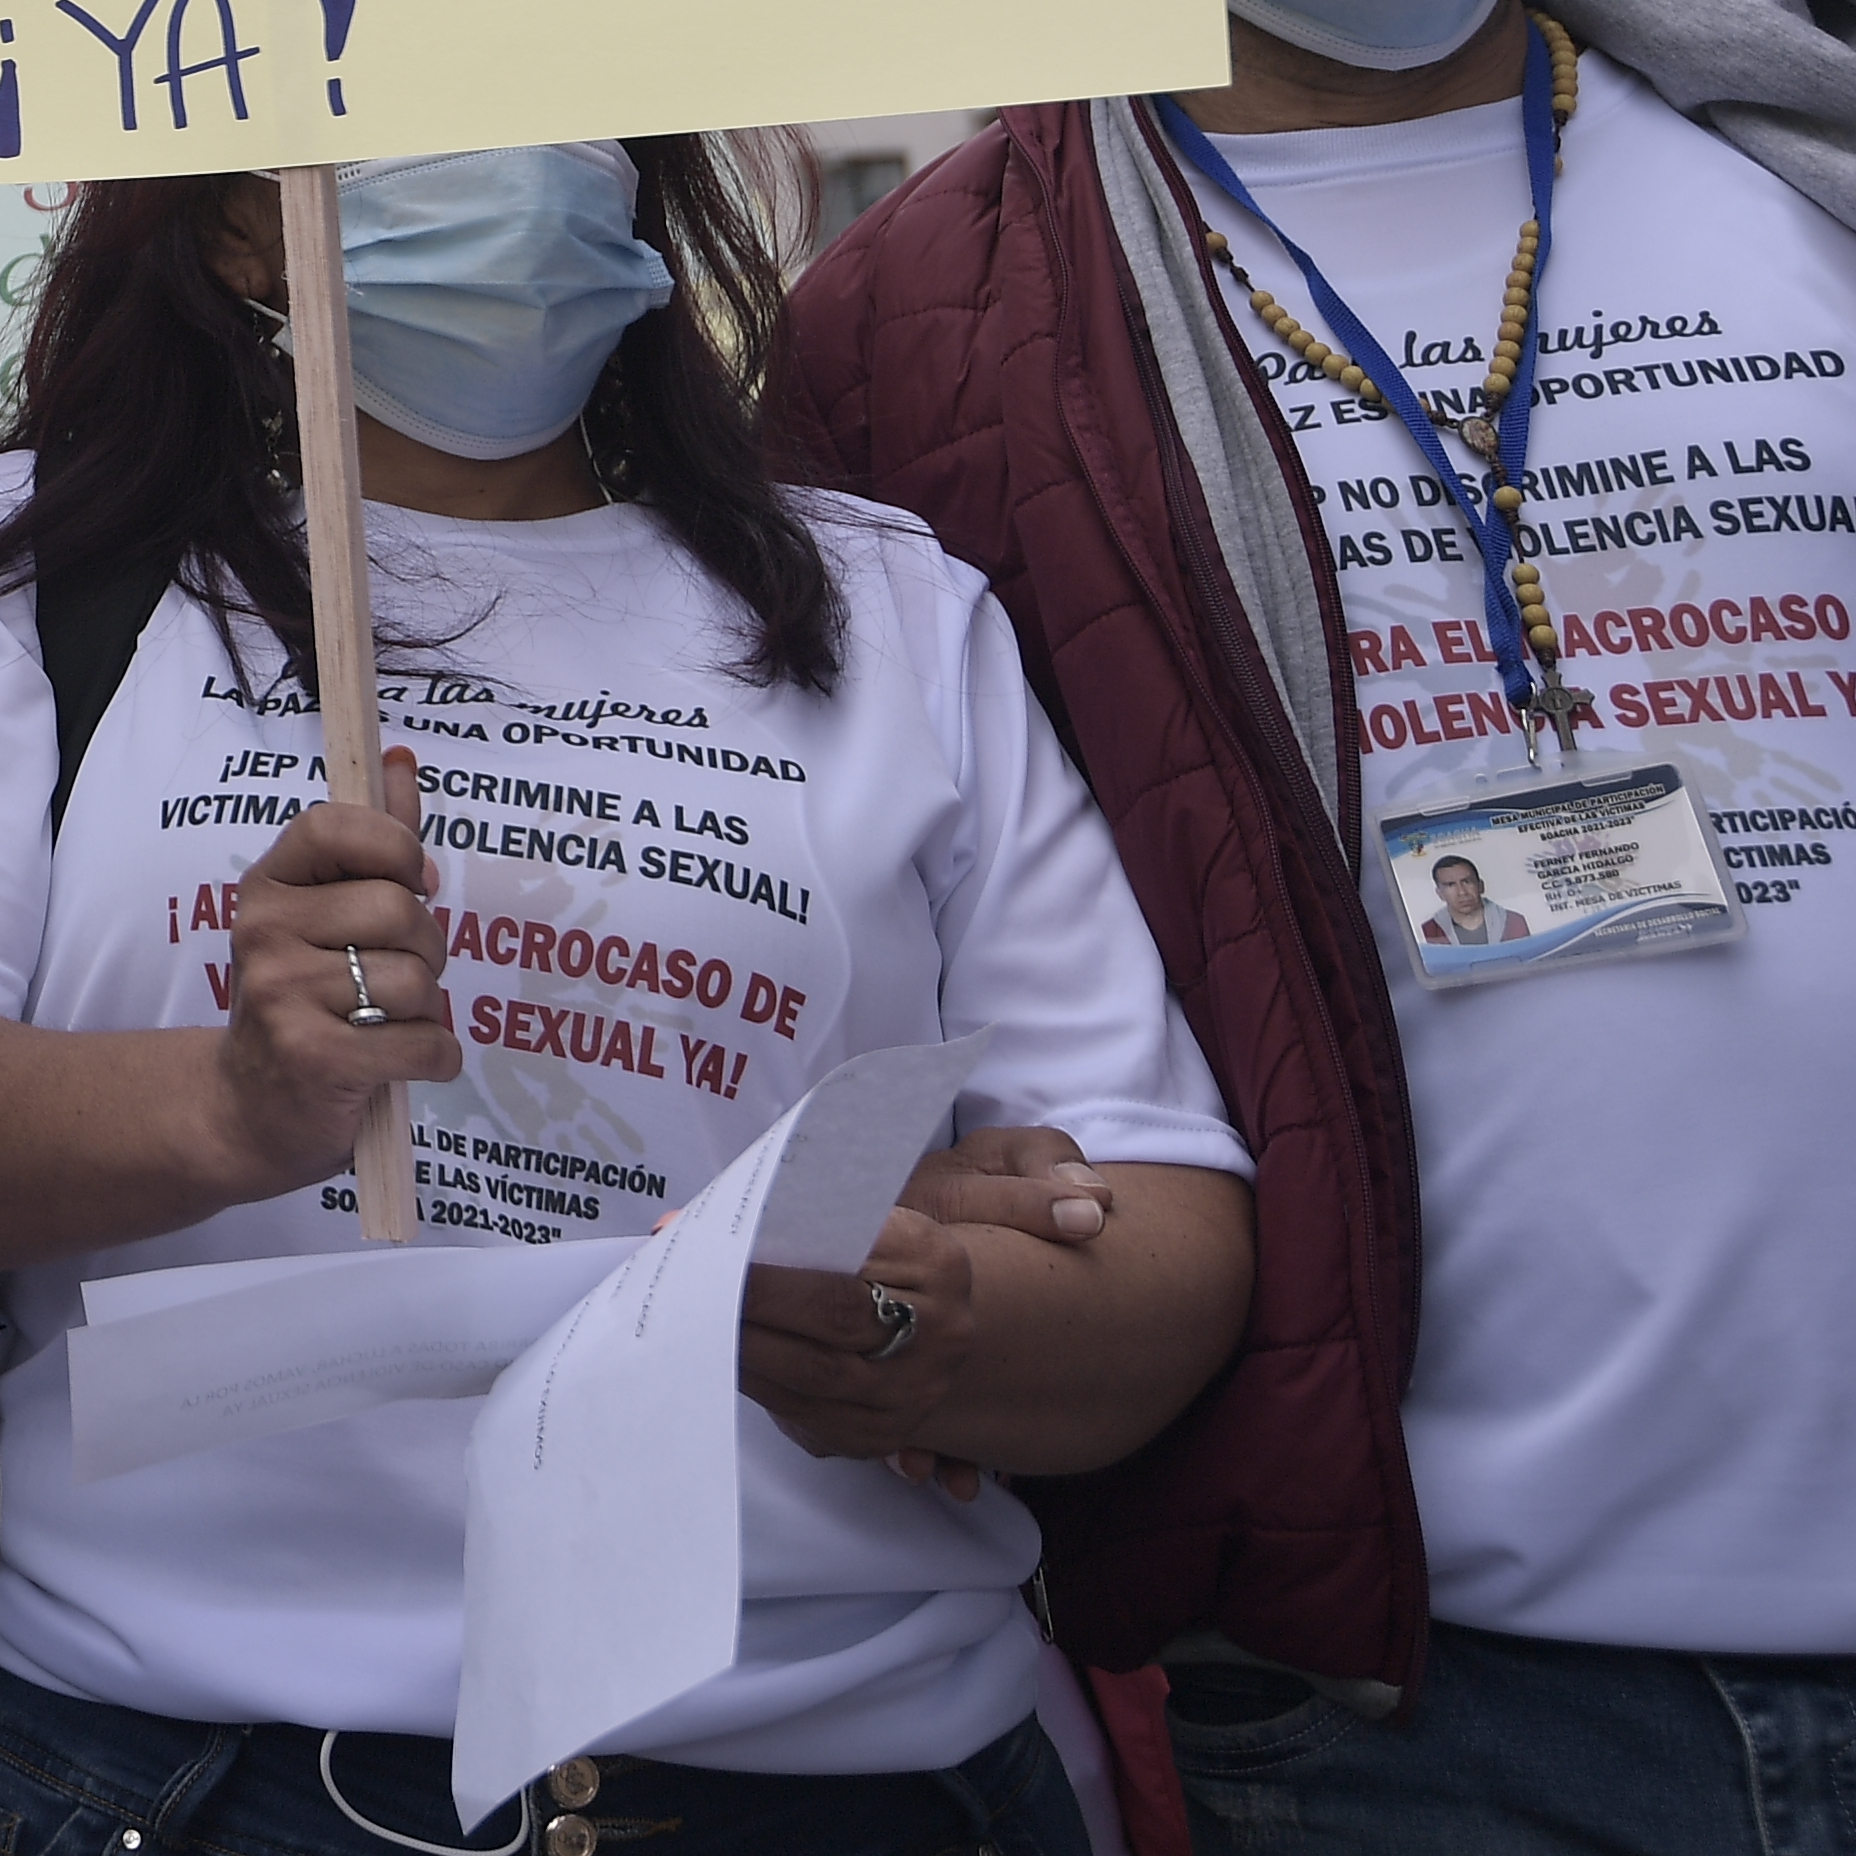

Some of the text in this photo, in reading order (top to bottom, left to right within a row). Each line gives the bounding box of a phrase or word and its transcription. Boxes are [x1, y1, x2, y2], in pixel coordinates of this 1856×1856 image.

[1338, 437, 1813, 513] NO A LAS
[1405, 527, 1464, 563] DE
[514, 689, 711, 730] mujeres
[1608, 670, 1826, 728] SEXUAL
[402, 715, 491, 743] UNA
[502, 721, 807, 783] OPORTUNIDAD
[631, 799, 662, 828] A
[673, 803, 749, 846] LAS
[638, 846, 811, 927] SEXUAL!
[739, 971, 807, 1041] DE
[468, 995, 749, 1101] SEXUAL YA!
[436, 1128, 666, 1199] DE PARTICIPACIÓN
[437, 1163, 600, 1221] LAS VÍCTIMAS
